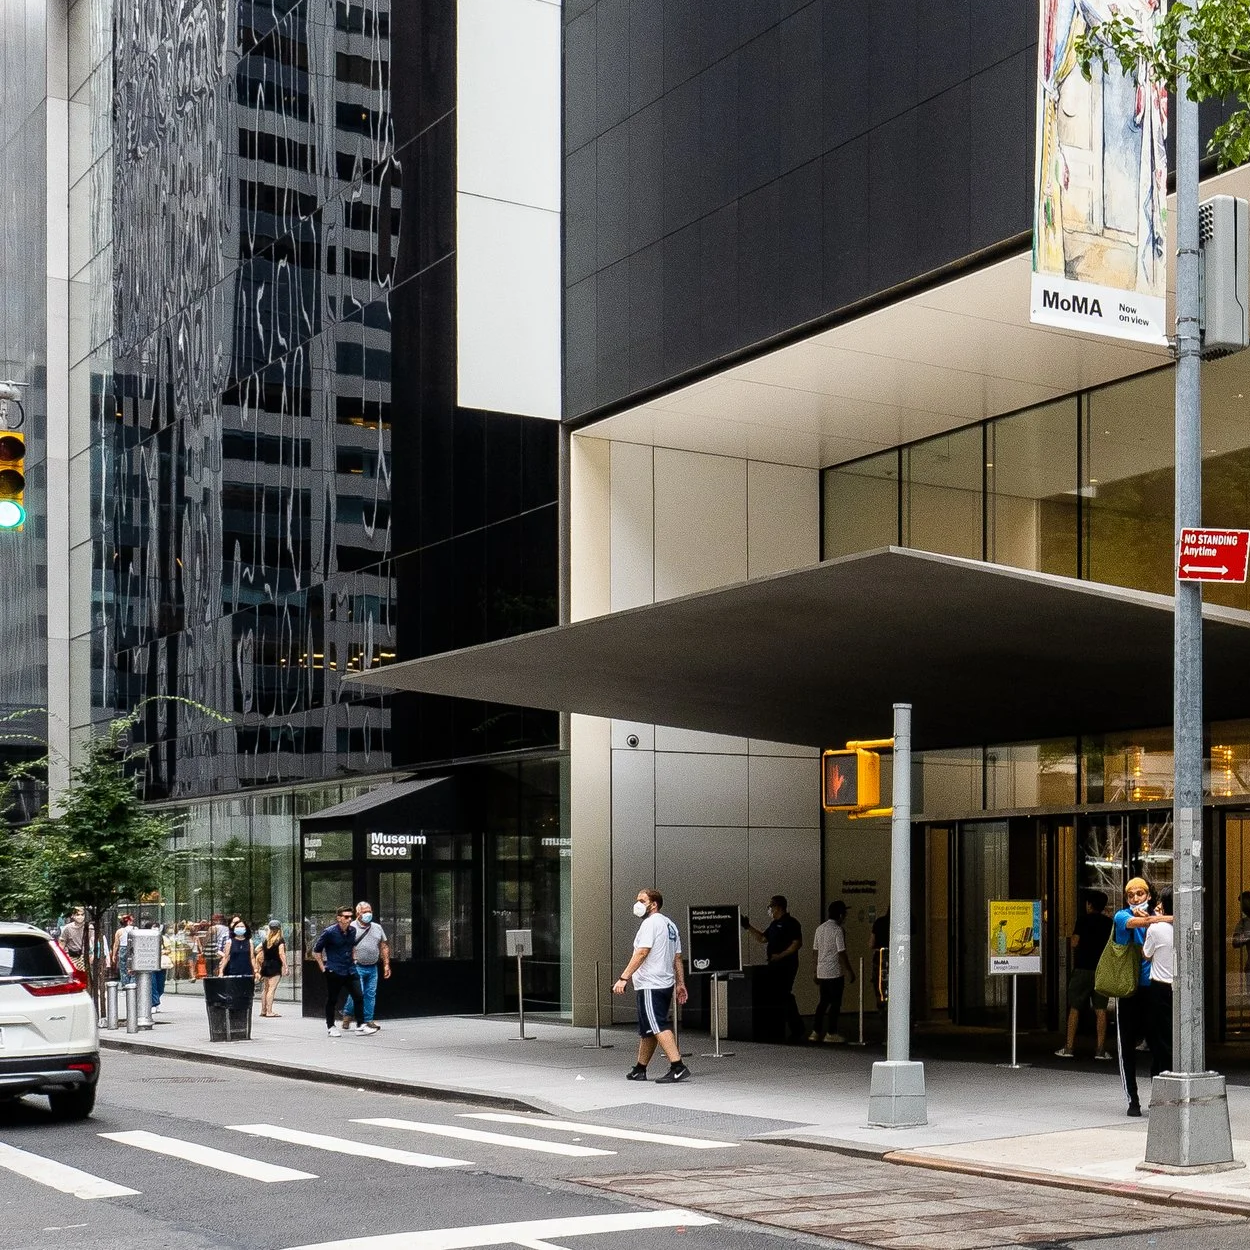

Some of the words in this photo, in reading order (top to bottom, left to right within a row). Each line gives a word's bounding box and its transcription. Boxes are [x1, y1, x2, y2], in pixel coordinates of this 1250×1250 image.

[1043, 289, 1103, 318] MoMA
[1119, 303, 1137, 315] Now
[1119, 314, 1130, 323] on
[1131, 316, 1150, 327] view
[1184, 534, 1197, 544] NO
[1197, 535, 1238, 546] STANDING
[1183, 545, 1217, 558] Anytime
[371, 833, 426, 845] Museum
[371, 844, 407, 856] Store
